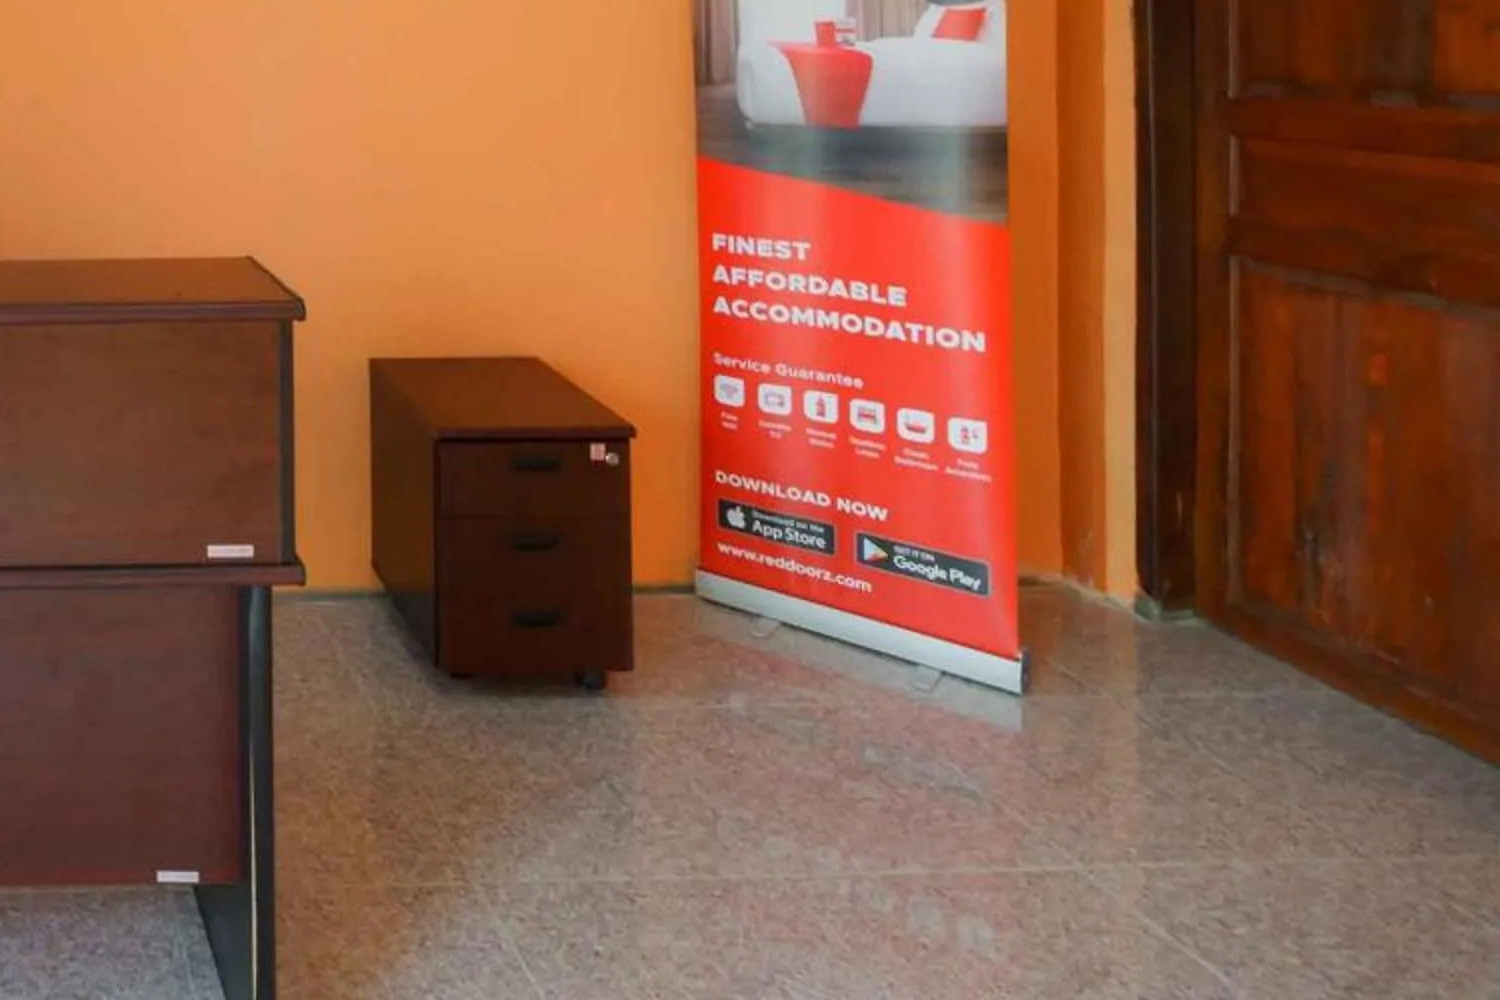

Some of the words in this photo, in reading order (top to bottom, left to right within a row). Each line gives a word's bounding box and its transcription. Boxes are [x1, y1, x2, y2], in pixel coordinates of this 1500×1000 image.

[712, 233, 812, 261] FINEST
[712, 265, 908, 307] AFFORDABLE
[712, 296, 987, 353] ACCOMMODATION
[713, 352, 771, 375] Service
[775, 362, 865, 389] Guarantee
[714, 470, 832, 508] DOWNLOAD
[836, 496, 889, 522] NOW
[752, 519, 783, 541] App
[784, 527, 827, 549] Store
[717, 542, 873, 593] www.reddoorz.com
[893, 554, 948, 581] Google
[949, 567, 982, 591] Play
